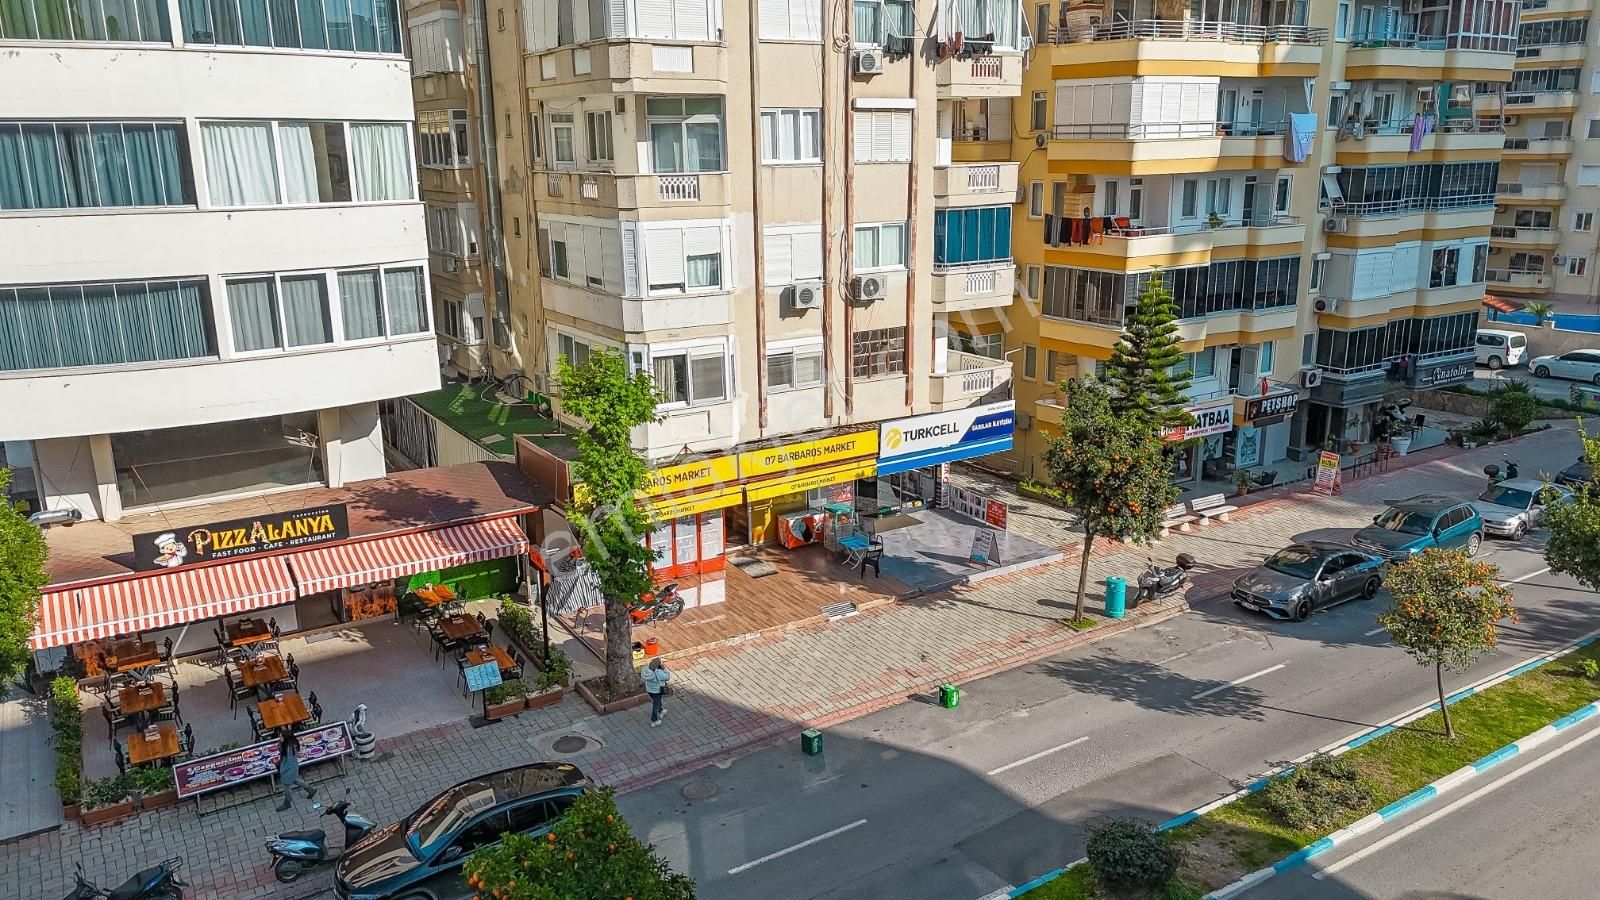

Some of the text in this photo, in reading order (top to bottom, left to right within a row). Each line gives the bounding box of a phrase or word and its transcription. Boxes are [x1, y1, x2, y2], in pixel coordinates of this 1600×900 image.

[1260, 394, 1299, 412] PETSHOP
[902, 422, 960, 442] TURKCELL
[764, 441, 857, 465] 07 BARBAROS MARKET
[674, 467, 711, 483] MARKET
[211, 532, 336, 558] FAST FOOD CAFE RESTAURANT
